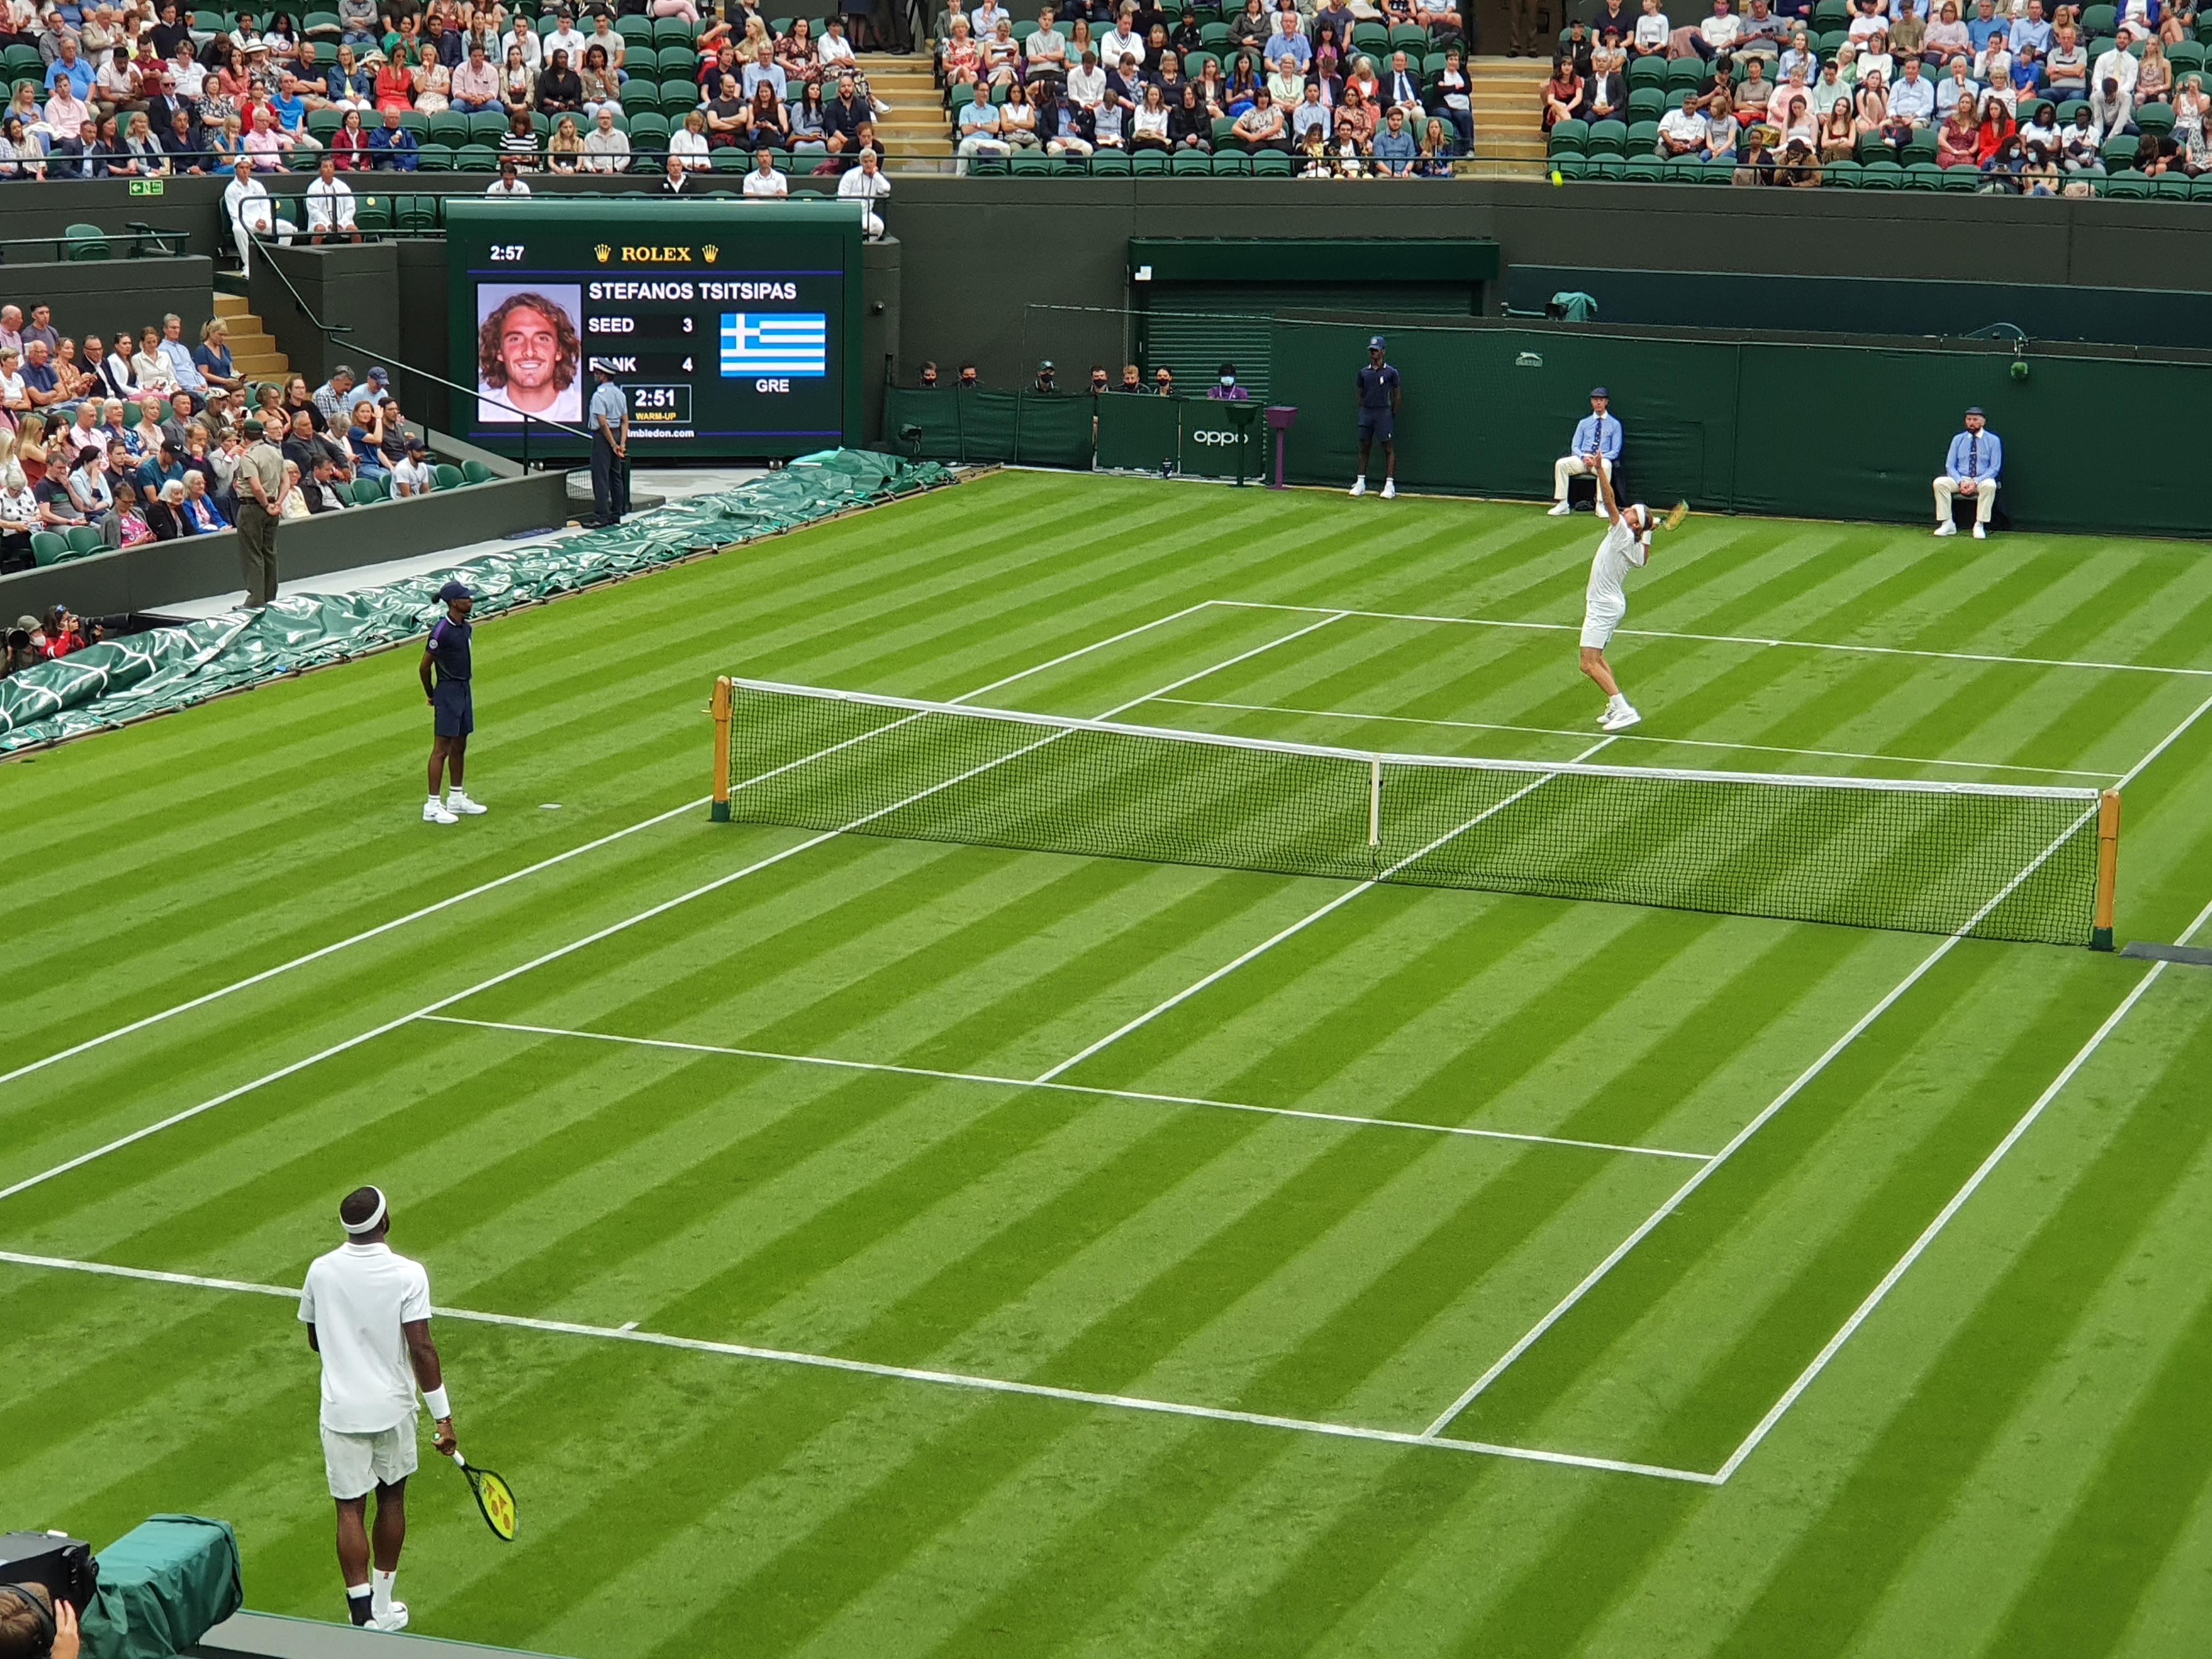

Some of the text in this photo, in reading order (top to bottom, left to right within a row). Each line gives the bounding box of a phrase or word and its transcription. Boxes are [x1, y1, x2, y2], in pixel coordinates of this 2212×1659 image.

[490, 245, 524, 260] 2:57
[622, 247, 691, 261] ROLEX
[589, 283, 797, 300] STEFANOS TSITSIPAS
[588, 317, 693, 332] SEED 3
[589, 357, 693, 371] RNK 4
[755, 379, 789, 392] GRE
[635, 389, 674, 407] 2:51
[627, 429, 695, 438] imbledon.com
